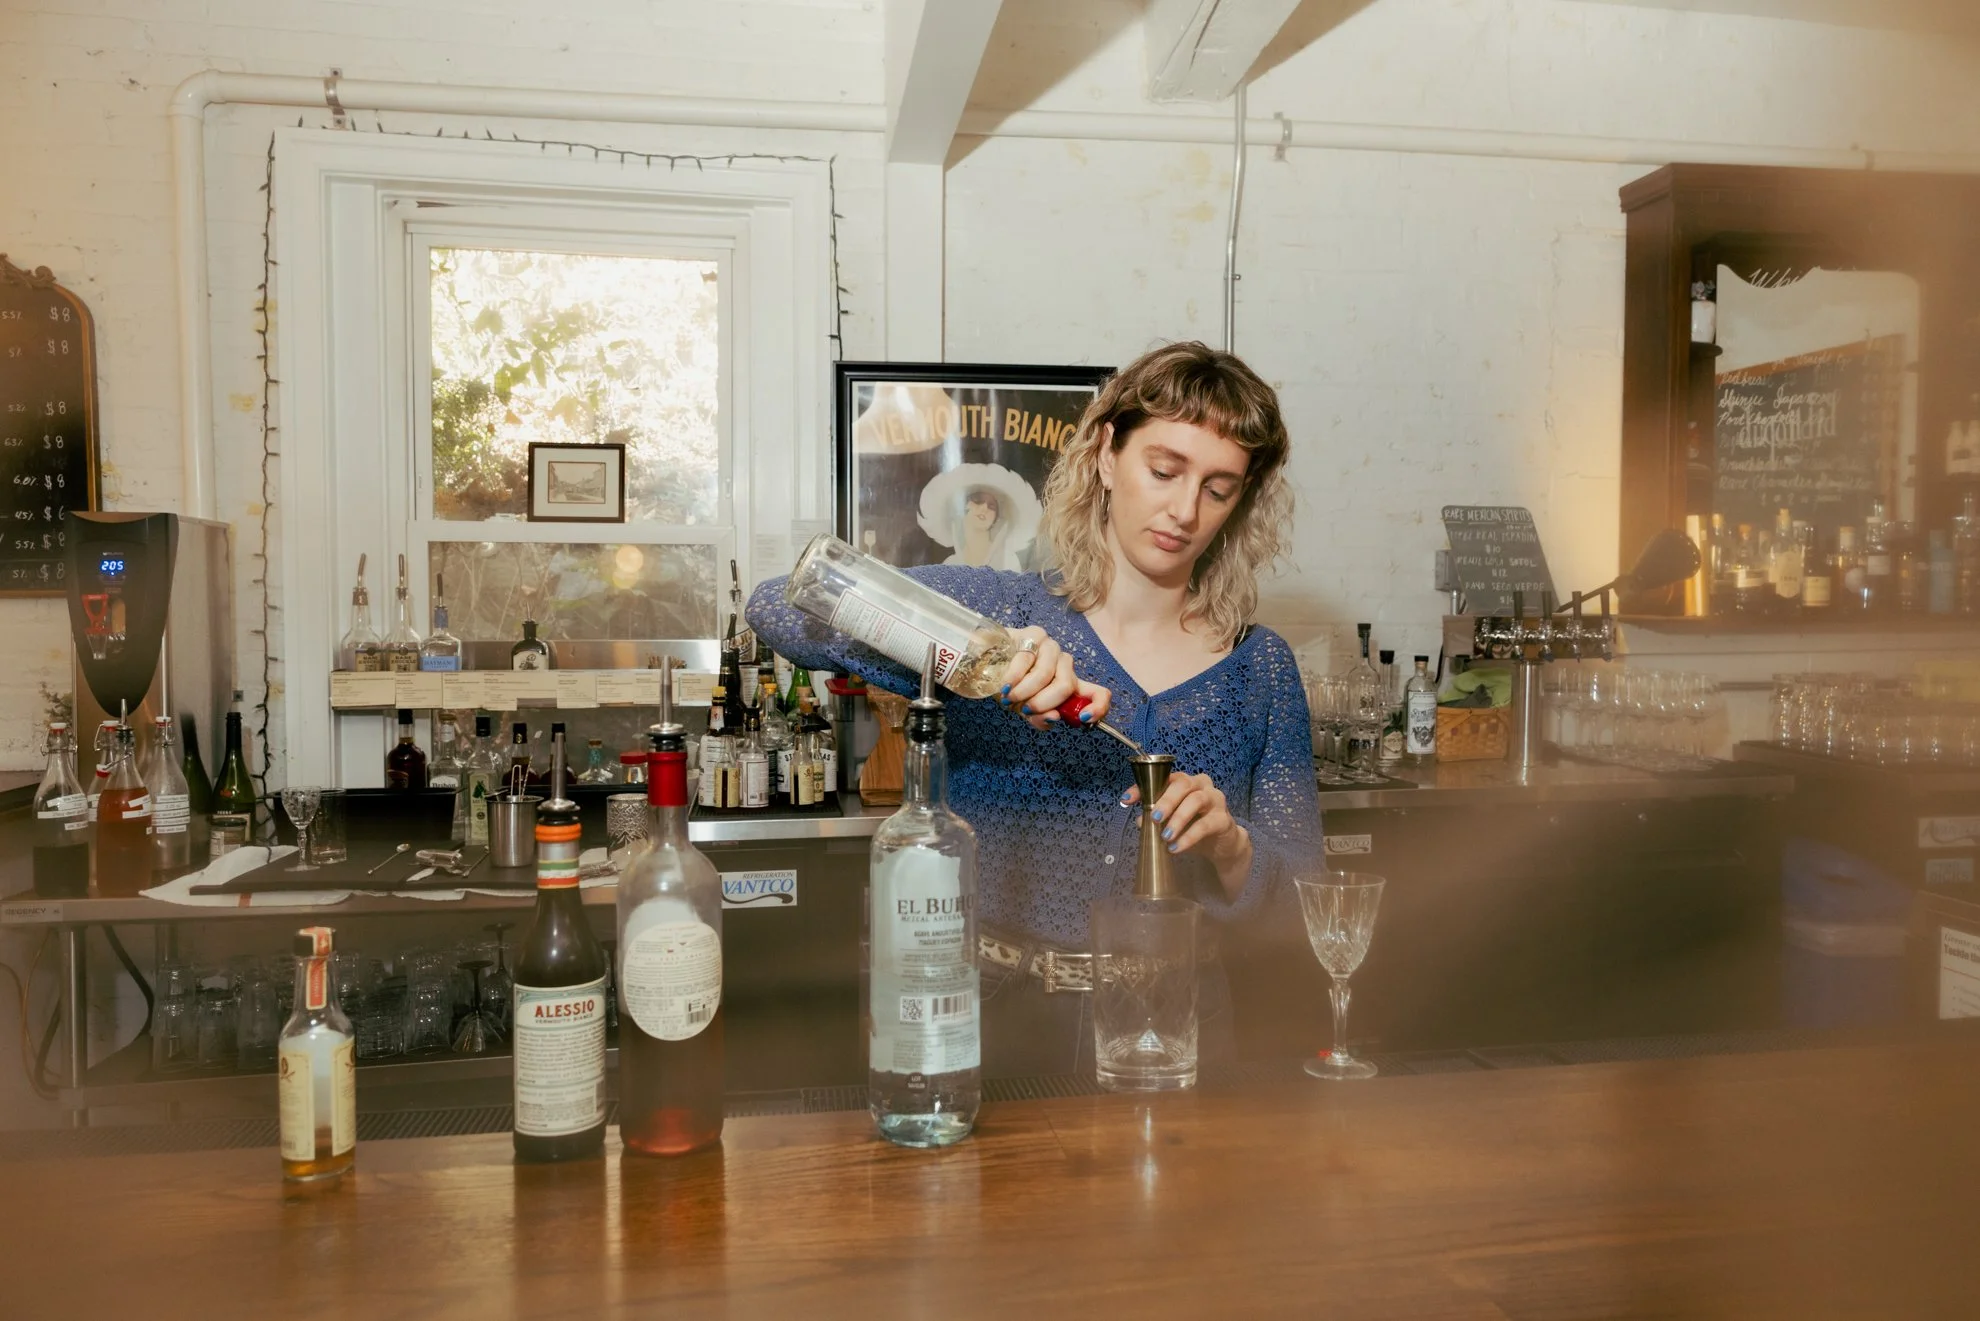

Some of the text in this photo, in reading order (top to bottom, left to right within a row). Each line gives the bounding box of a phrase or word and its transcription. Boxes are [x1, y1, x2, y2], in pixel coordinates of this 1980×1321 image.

[1003, 408, 1078, 455] BIANC
[101, 560, 124, 570] 205
[897, 899, 920, 914] EL
[535, 999, 595, 1018] ALESSIO
